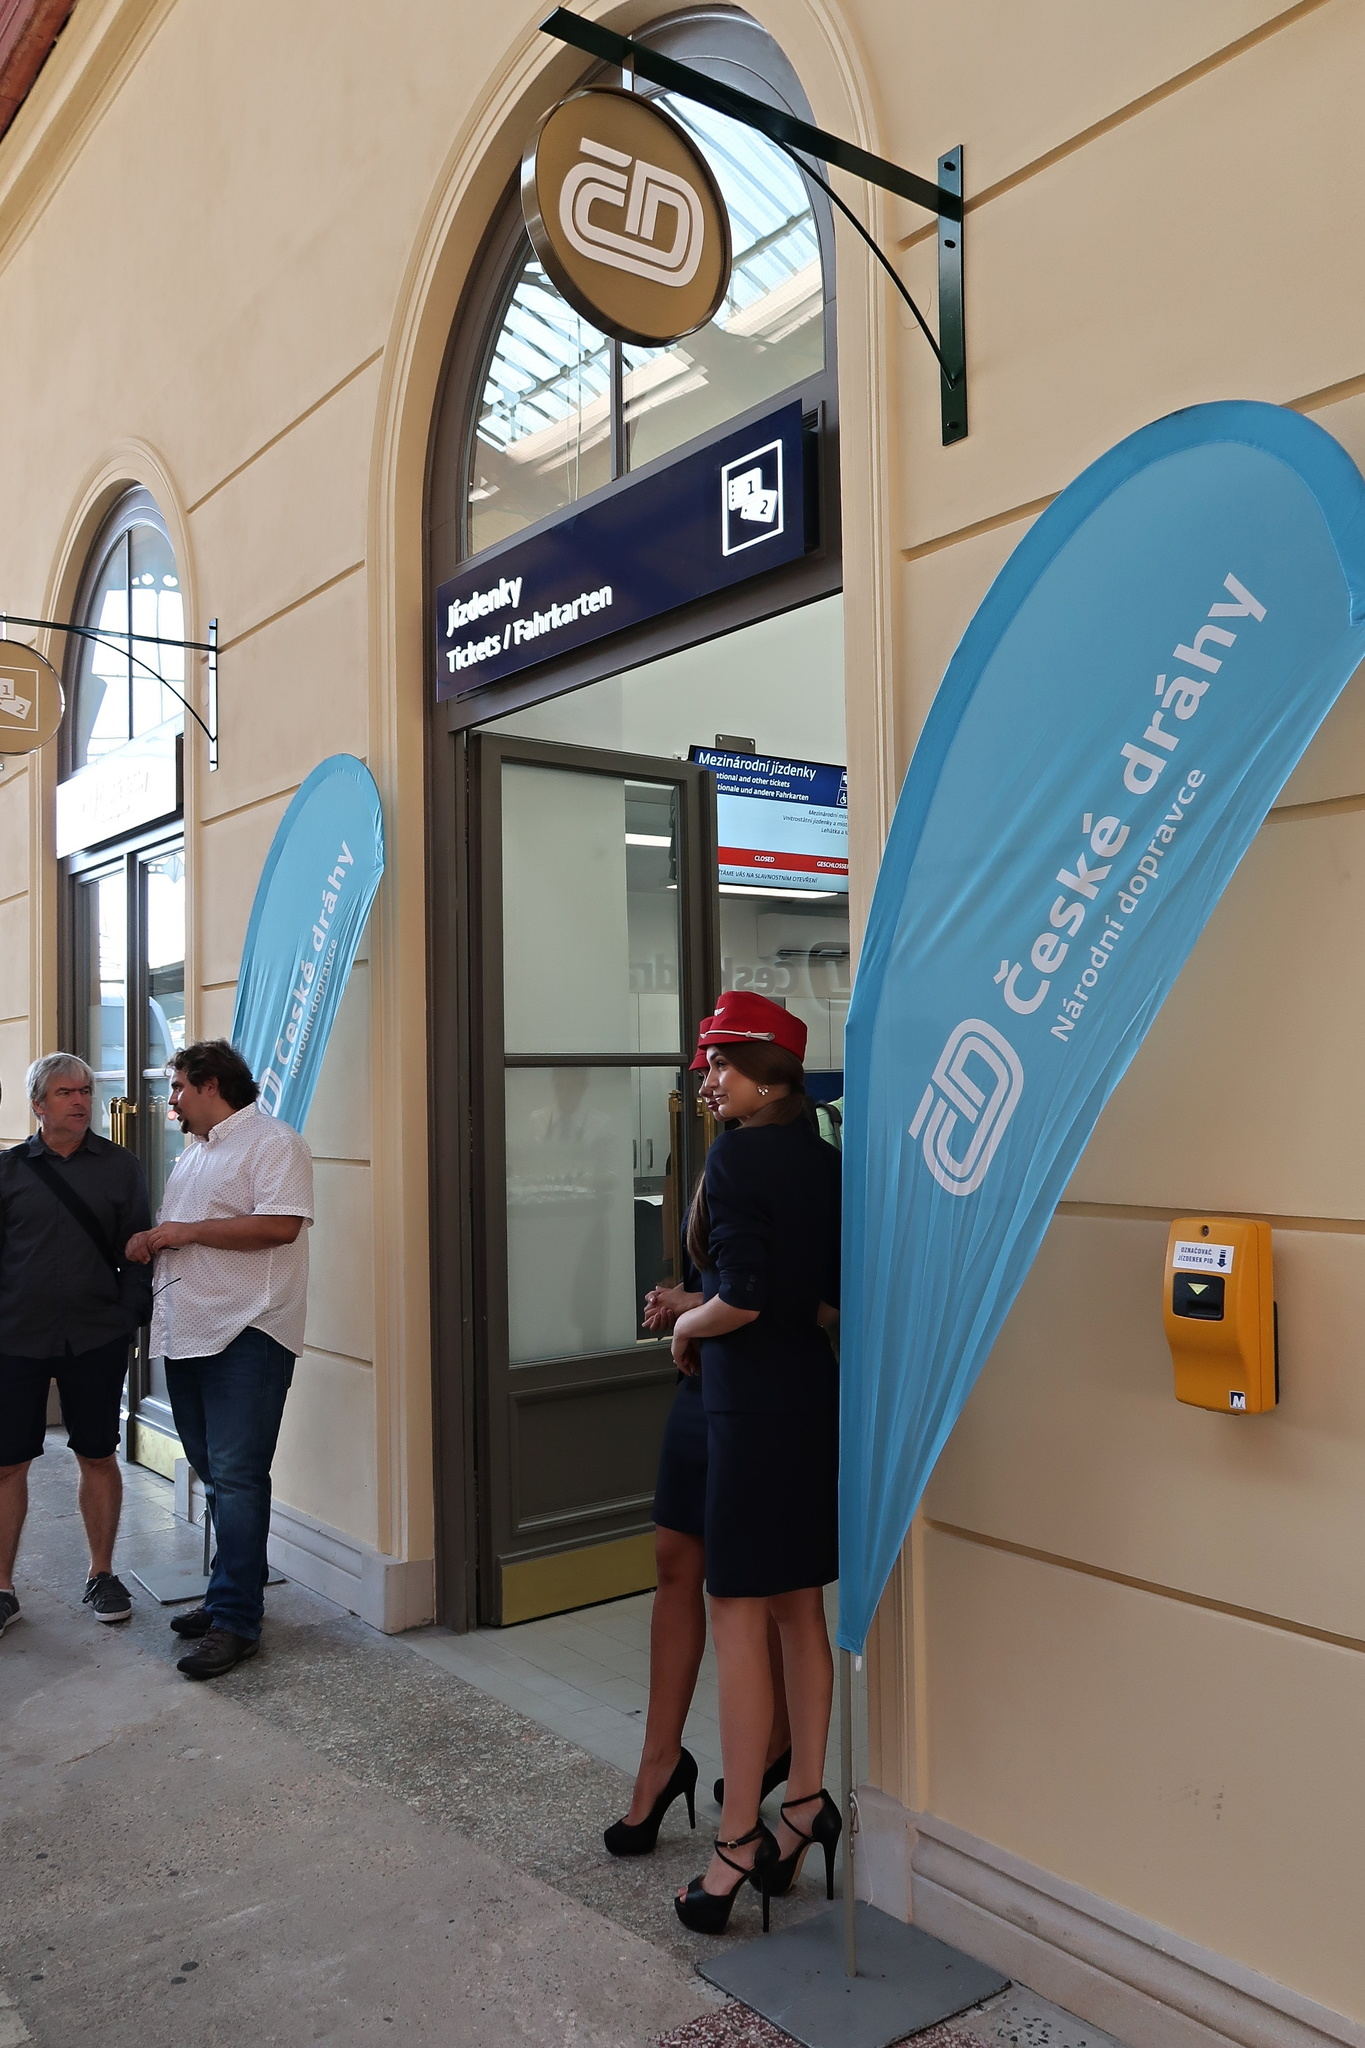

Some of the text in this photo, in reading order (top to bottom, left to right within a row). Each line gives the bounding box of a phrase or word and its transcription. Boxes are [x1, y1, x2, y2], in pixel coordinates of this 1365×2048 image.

[446, 577, 523, 637] Jízdenky
[446, 634, 501, 673] Tickets
[513, 585, 613, 645] Fahrkarten
[698, 751, 817, 781] Mezinárodní jízdenky
[739, 775, 751, 784] and
[752, 776, 769, 785] other
[769, 778, 791, 788] tickets
[740, 786, 753, 795] und
[753, 788, 775, 798] andere
[775, 790, 810, 802] Fahrkarten
[993, 572, 1268, 1016] České dráhy
[754, 855, 775, 863] CLOSED
[312, 840, 355, 953] dráhy
[1050, 767, 1207, 1043] Národní dopravce
[1203, 1257, 1214, 1265] PID
